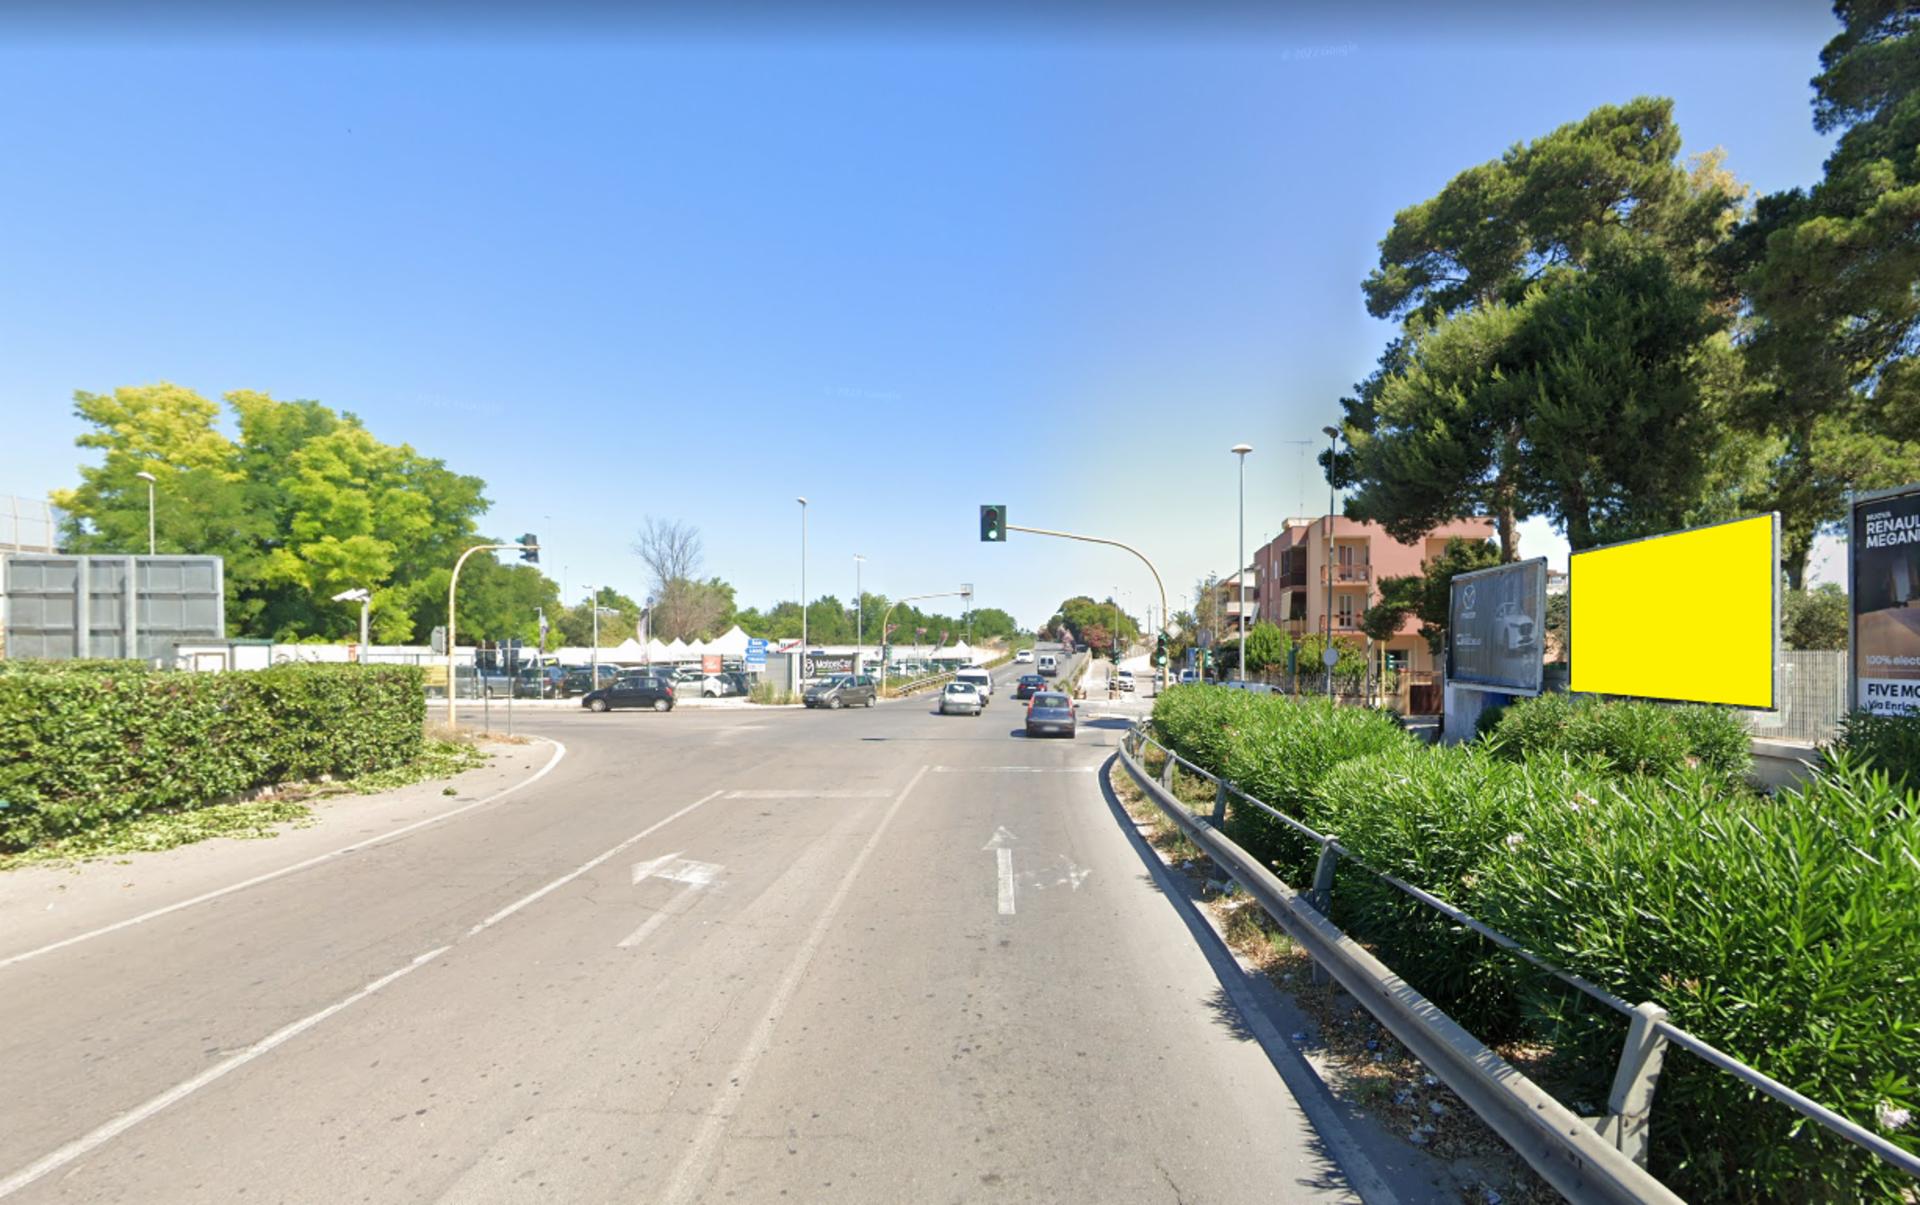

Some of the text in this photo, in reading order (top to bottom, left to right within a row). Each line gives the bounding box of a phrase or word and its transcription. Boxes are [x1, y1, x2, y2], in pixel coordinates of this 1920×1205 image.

[1866, 529, 1920, 549] MEGAN
[1866, 655, 1892, 665] 100%
[1868, 683, 1899, 697] FIVE
